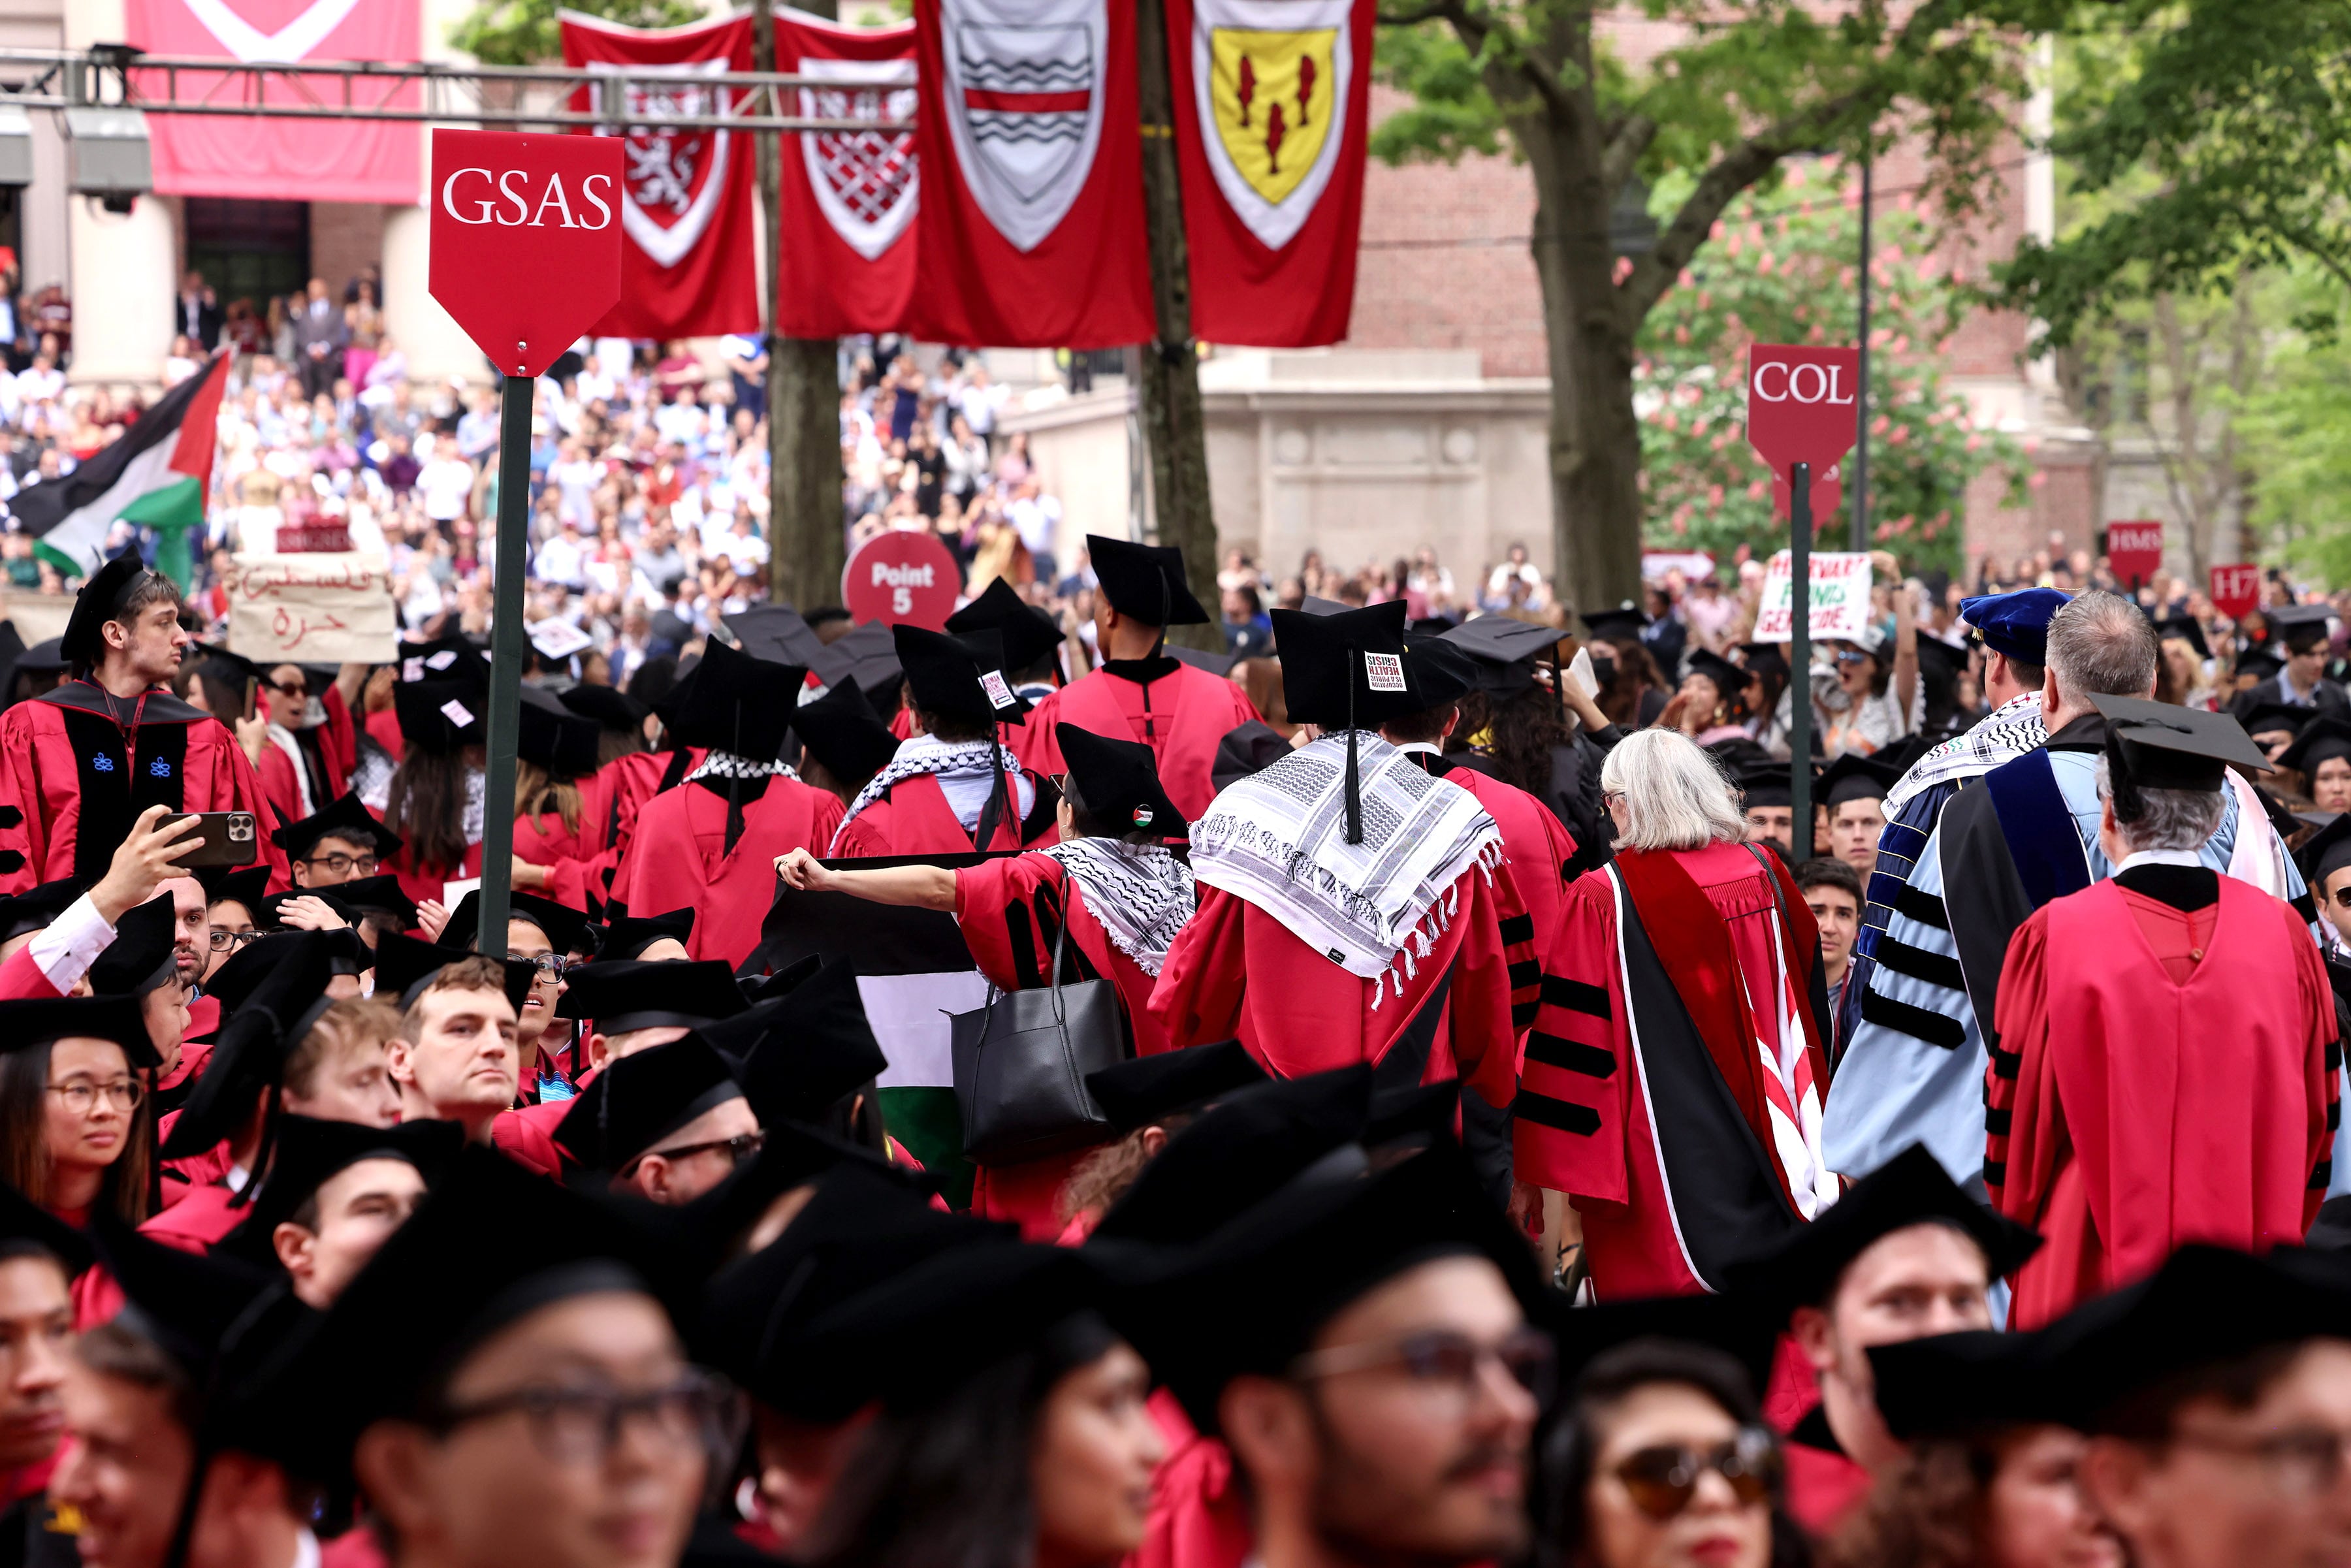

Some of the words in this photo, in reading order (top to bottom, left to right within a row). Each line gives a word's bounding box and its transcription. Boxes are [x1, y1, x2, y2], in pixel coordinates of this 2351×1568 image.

[442, 167, 612, 231] GSAS
[1753, 361, 1854, 405] COL
[871, 562, 935, 588] Point
[2215, 569, 2257, 600] H7
[892, 588, 912, 615] 5
[1367, 655, 1398, 666] CRISIS
[1368, 665, 1399, 675] HEALTH
